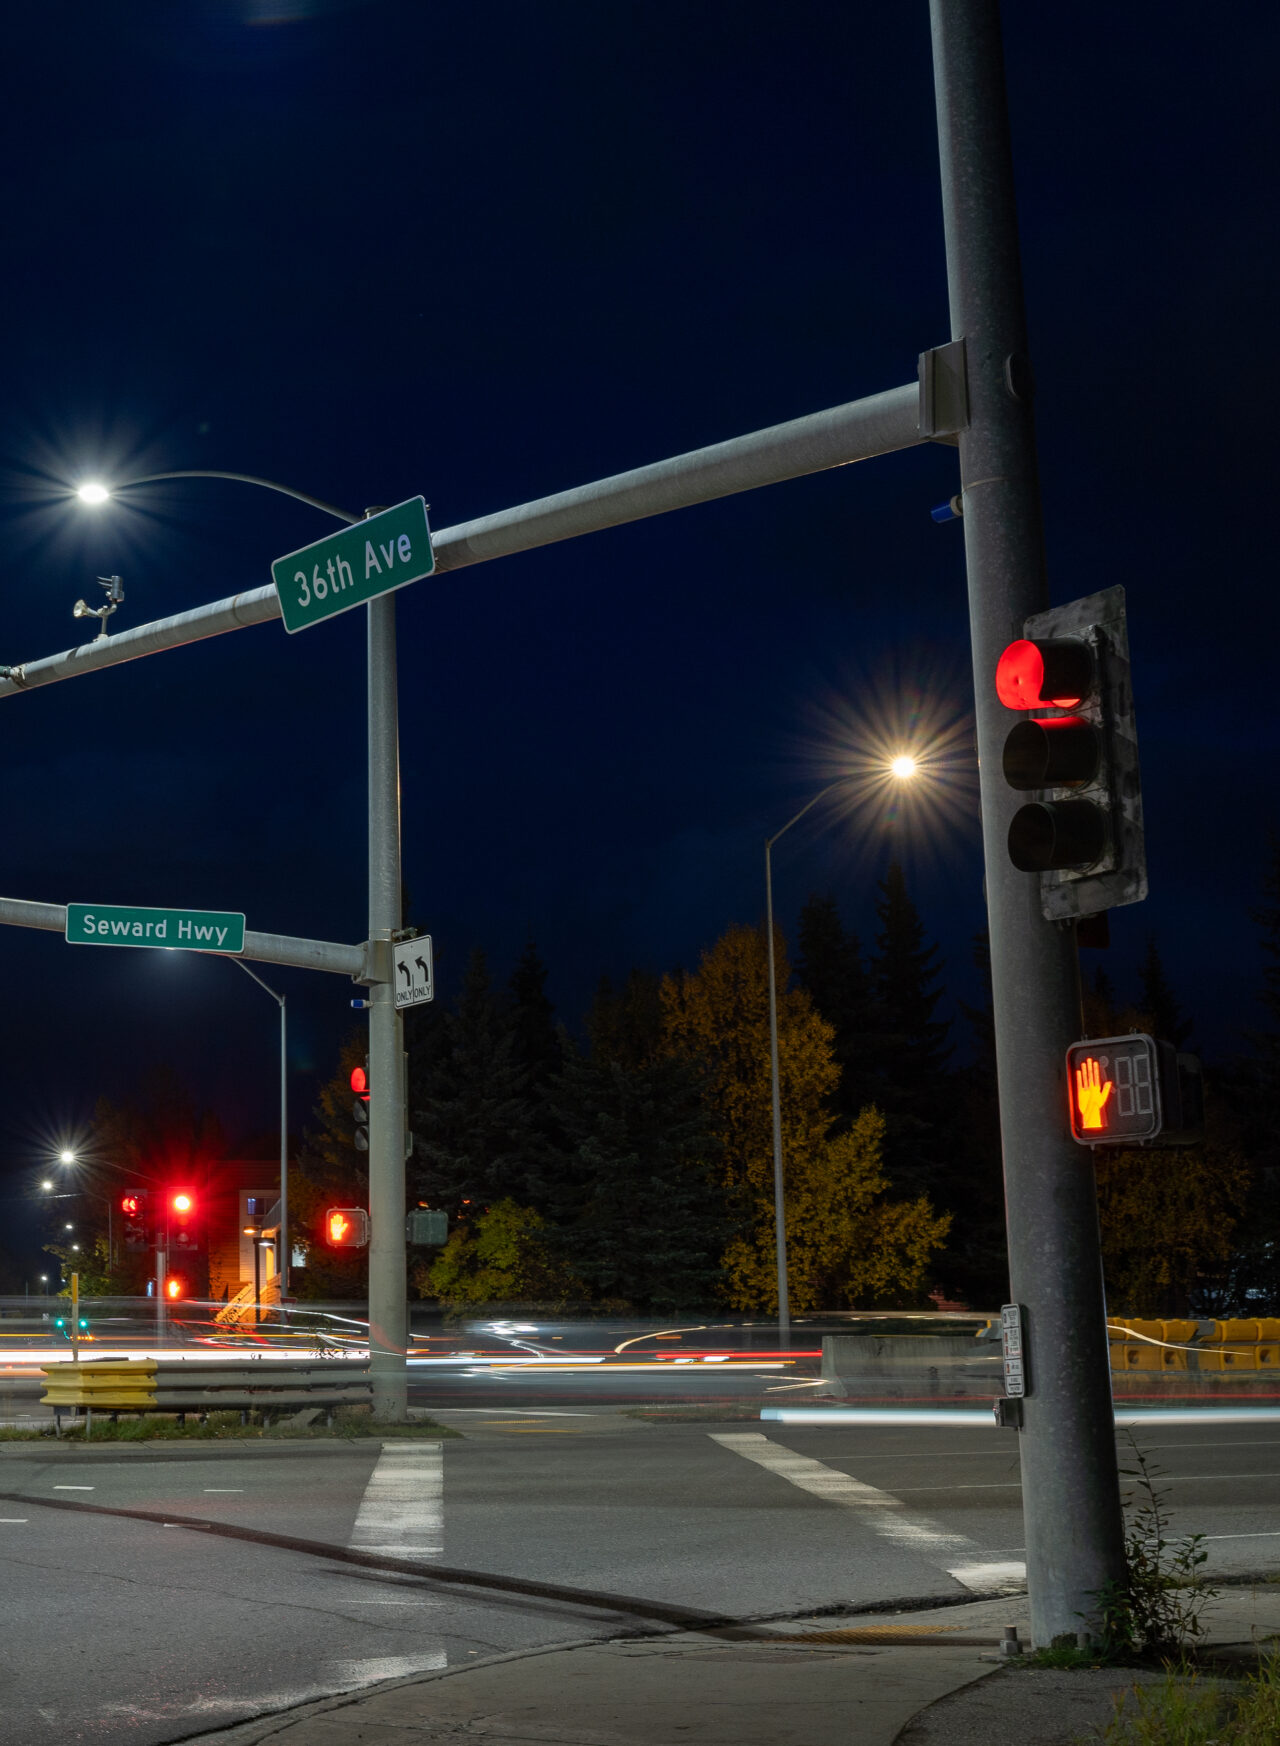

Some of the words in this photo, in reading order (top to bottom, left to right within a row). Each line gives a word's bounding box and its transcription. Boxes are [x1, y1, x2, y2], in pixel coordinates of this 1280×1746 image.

[294, 554, 354, 607] 36th
[365, 534, 411, 579] Ave
[83, 914, 168, 939] Seward
[178, 920, 229, 947] Hwy
[397, 989, 412, 1002] ONLY
[415, 985, 430, 998] ONLY
